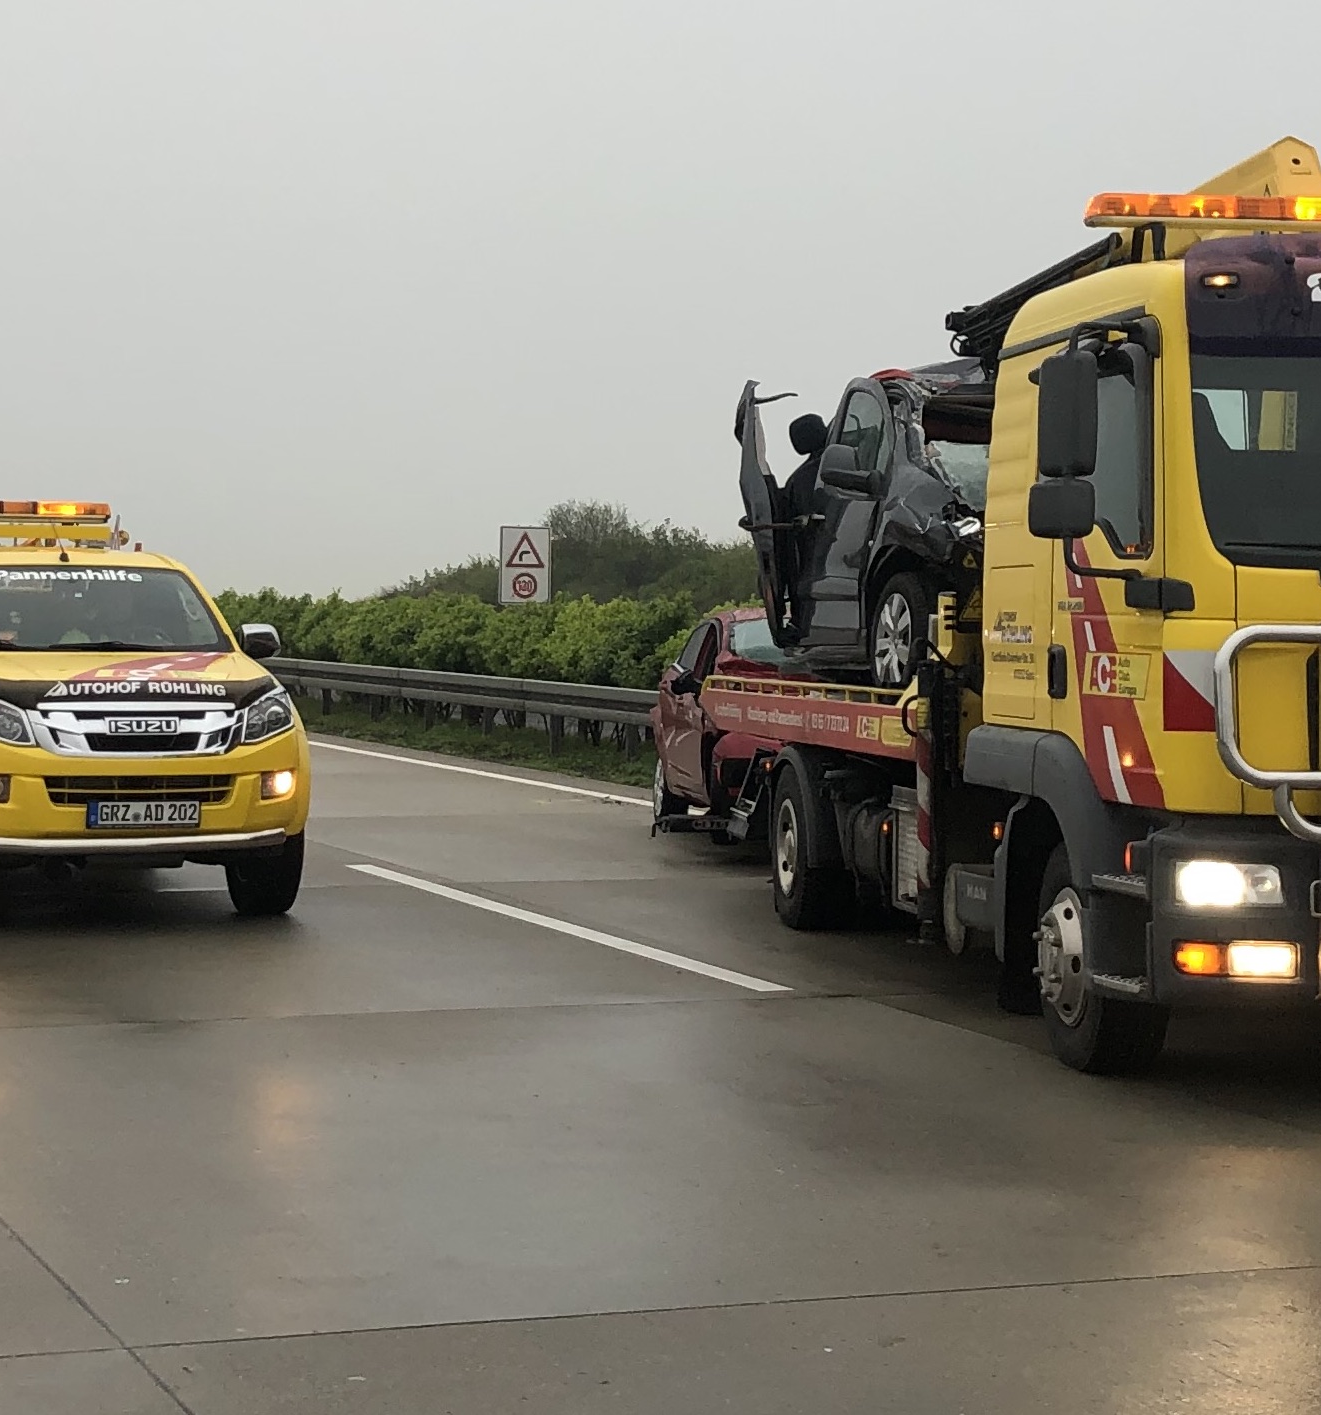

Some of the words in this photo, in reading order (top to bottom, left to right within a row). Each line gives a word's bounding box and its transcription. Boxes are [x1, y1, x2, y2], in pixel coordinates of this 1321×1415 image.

[147, 681, 227, 697] RÜHLING
[110, 719, 177, 733] ISUZU
[100, 804, 130, 822] GRZ
[143, 804, 165, 822] AD
[168, 803, 198, 822] 202
